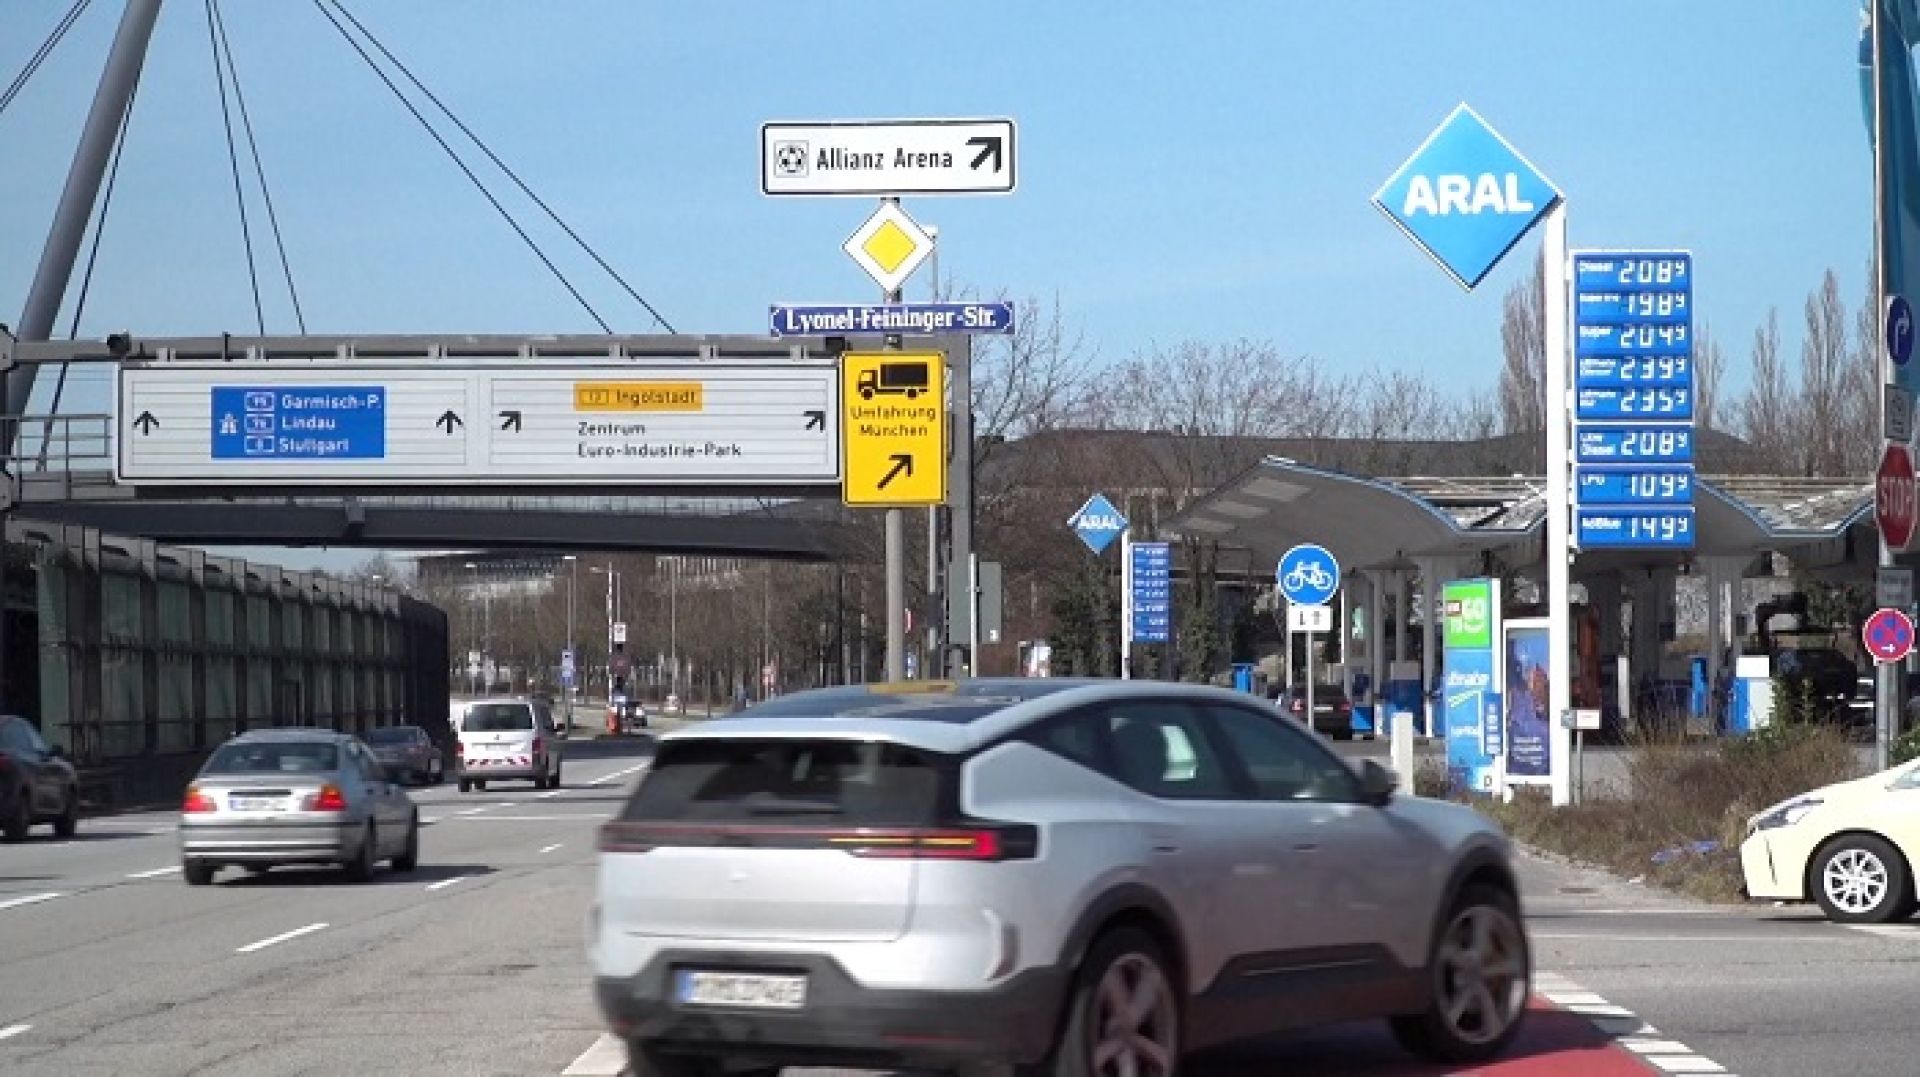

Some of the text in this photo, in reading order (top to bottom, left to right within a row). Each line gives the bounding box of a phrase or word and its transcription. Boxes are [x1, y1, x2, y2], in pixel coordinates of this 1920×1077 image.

[817, 147, 953, 171] Allianz Arena
[1403, 172, 1535, 217] ARAL
[787, 306, 997, 333] Lyonel-Feininger-Str.
[616, 389, 696, 406] Ingolstadt
[850, 405, 936, 422] Umfahrung
[281, 415, 336, 431] Lindau
[577, 422, 646, 437] Zentrum
[860, 422, 928, 437] München
[278, 437, 350, 456] Stuttgart
[577, 441, 742, 458] Euro-Industrie-Park
[1880, 475, 1913, 516] STOP
[1077, 514, 1120, 530] ARAL
